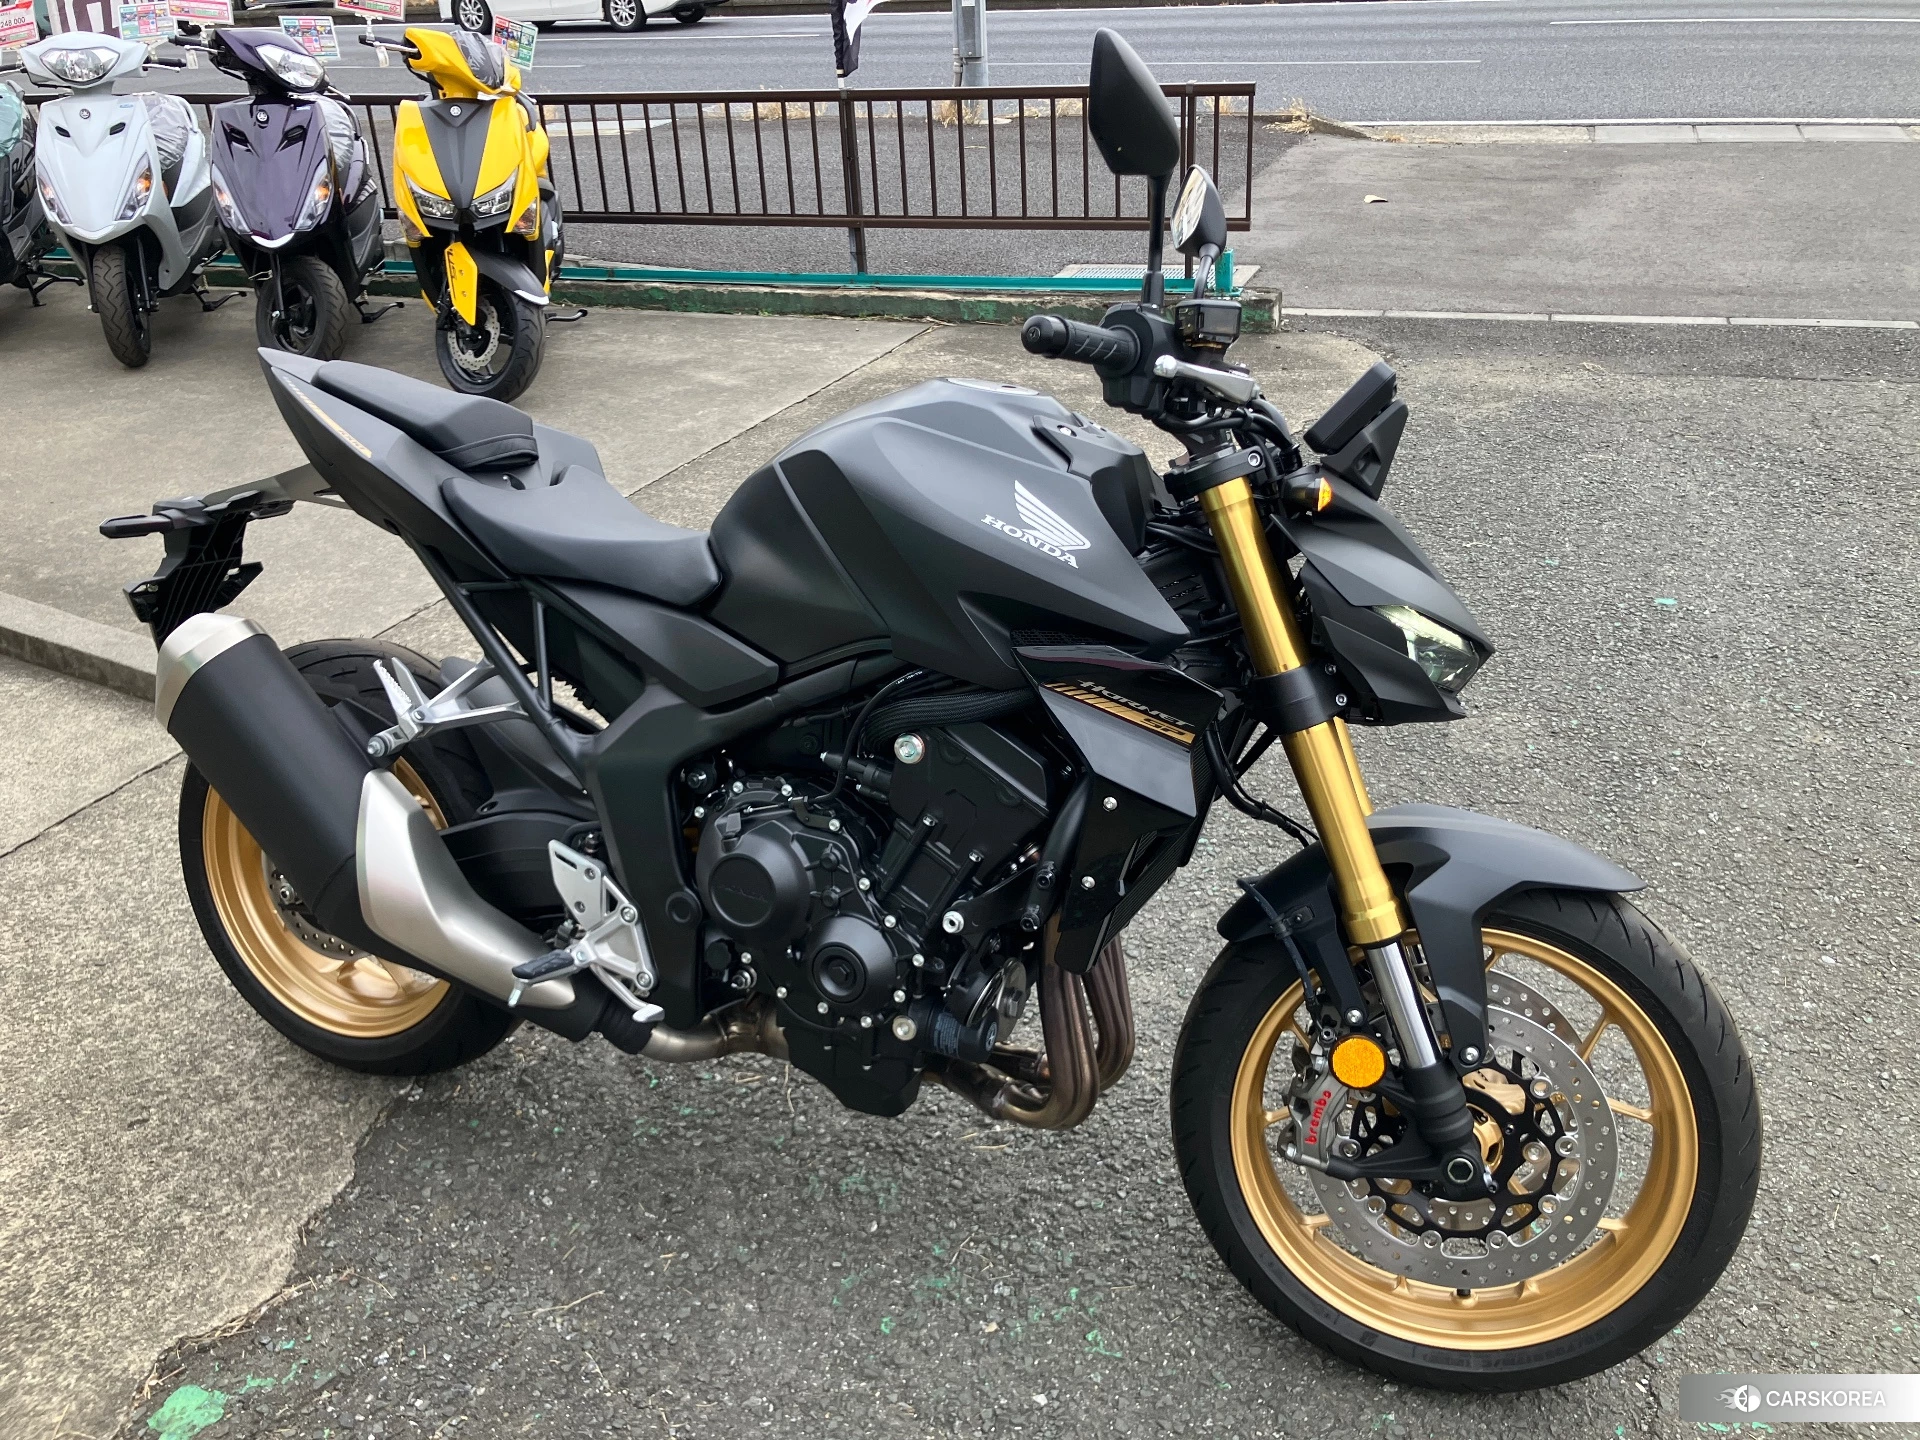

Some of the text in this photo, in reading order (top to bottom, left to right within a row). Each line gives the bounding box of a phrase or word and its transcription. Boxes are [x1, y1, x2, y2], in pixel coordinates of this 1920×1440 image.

[981, 514, 1079, 569] HONDA
[1077, 679, 1196, 728] HORNET
[1140, 717, 1187, 736] SP
[1304, 1090, 1332, 1144] brembo
